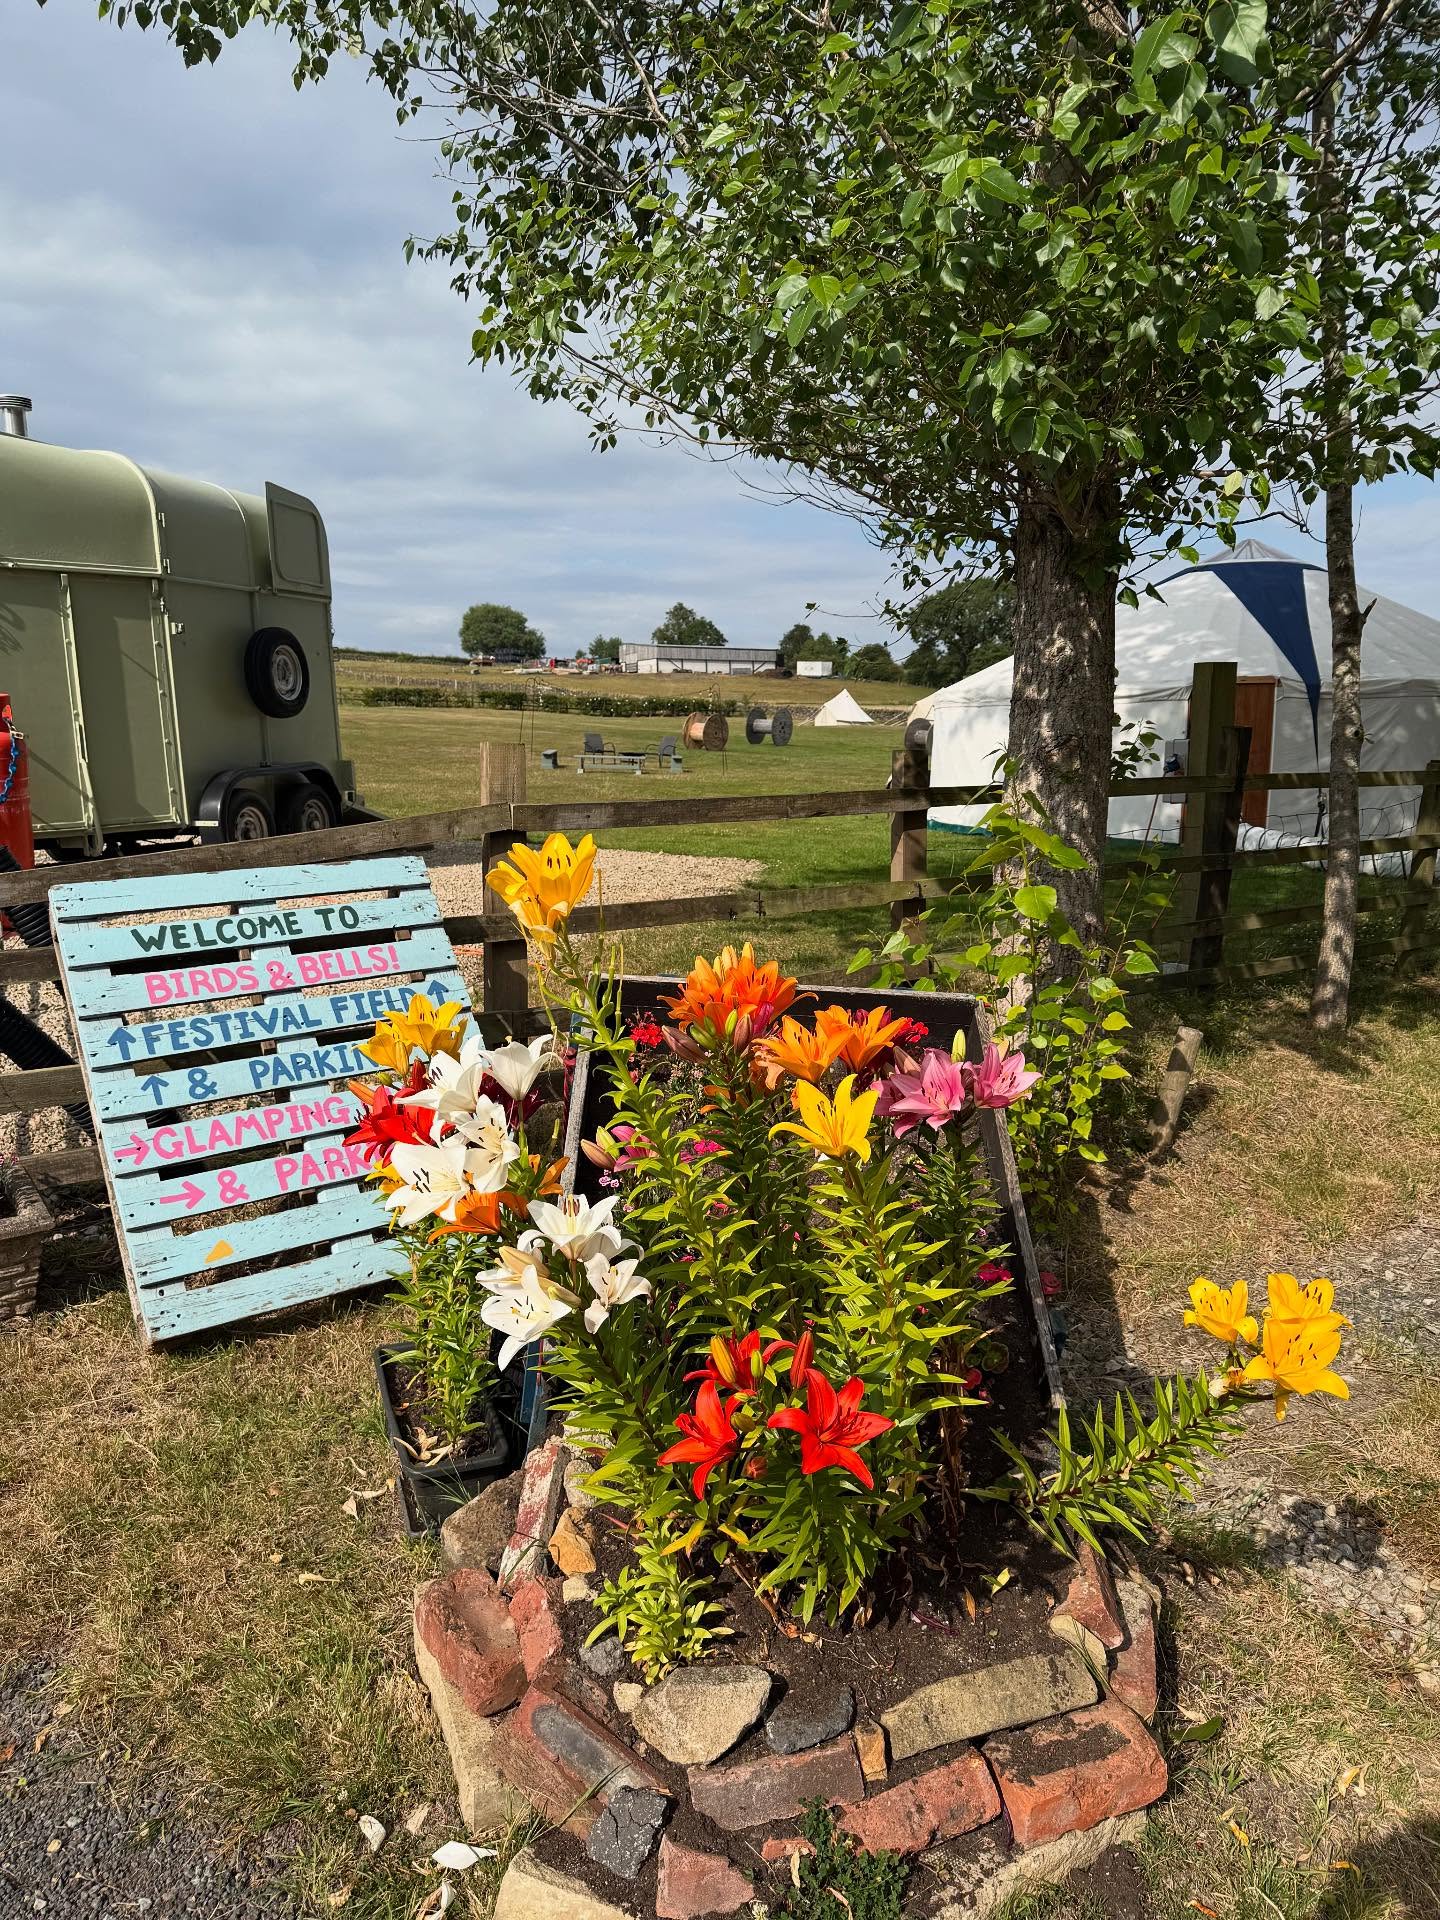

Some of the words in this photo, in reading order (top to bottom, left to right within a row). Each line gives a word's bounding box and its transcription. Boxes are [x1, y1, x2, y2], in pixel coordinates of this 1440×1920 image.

[130, 911, 303, 952] WELCOME
[314, 905, 360, 932] TO
[144, 965, 260, 1005] BIRDS
[265, 960, 296, 990] &
[296, 944, 401, 984] BELLS!
[141, 1003, 323, 1055] FESTIVAL
[187, 1067, 218, 1100] &
[248, 1042, 380, 1089] PARKIN
[152, 1096, 350, 1160] GLAMPING
[217, 1169, 250, 1204] &
